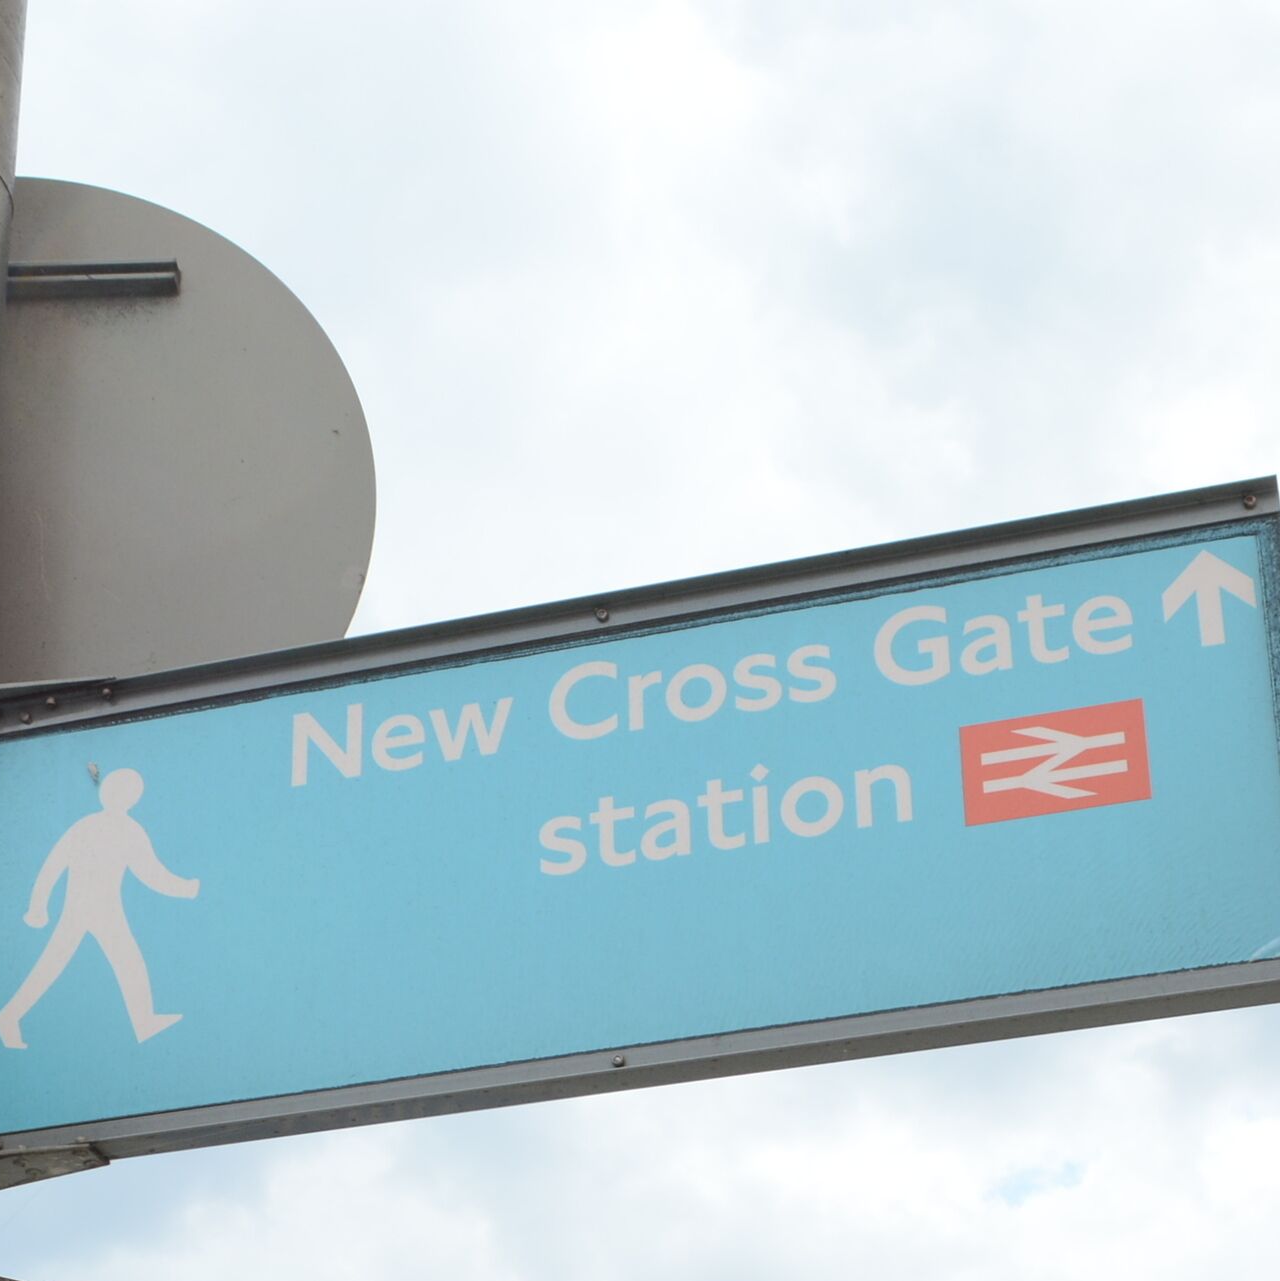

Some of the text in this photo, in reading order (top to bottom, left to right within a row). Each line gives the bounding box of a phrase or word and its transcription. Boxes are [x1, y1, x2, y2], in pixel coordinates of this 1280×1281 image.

[289, 591, 1135, 788] New Cross Gate
[537, 761, 914, 876] station
